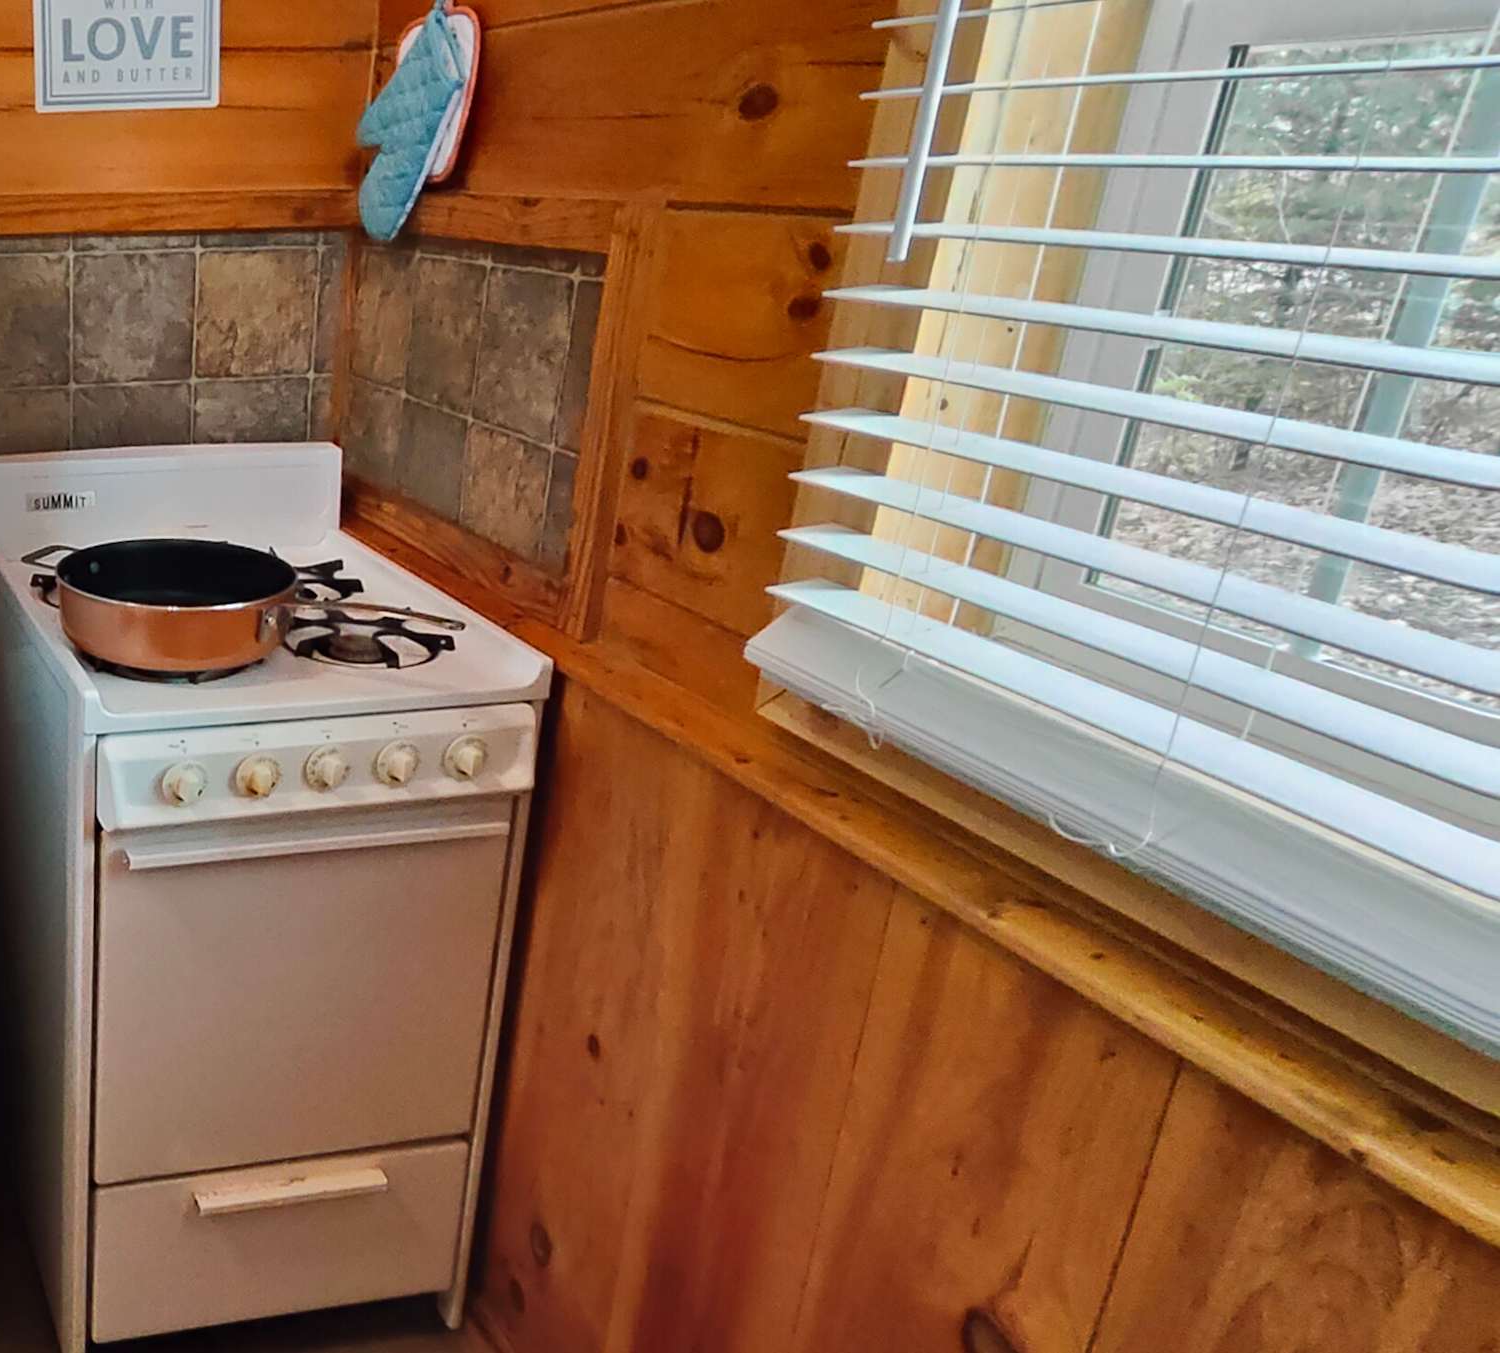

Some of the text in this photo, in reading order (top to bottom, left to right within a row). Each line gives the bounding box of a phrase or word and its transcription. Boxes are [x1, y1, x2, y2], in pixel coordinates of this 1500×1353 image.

[104, 0, 154, 10] WITH
[62, 15, 194, 62] LOVE
[62, 67, 193, 84] AND BUTTER
[34, 494, 86, 510] SUMMIT
